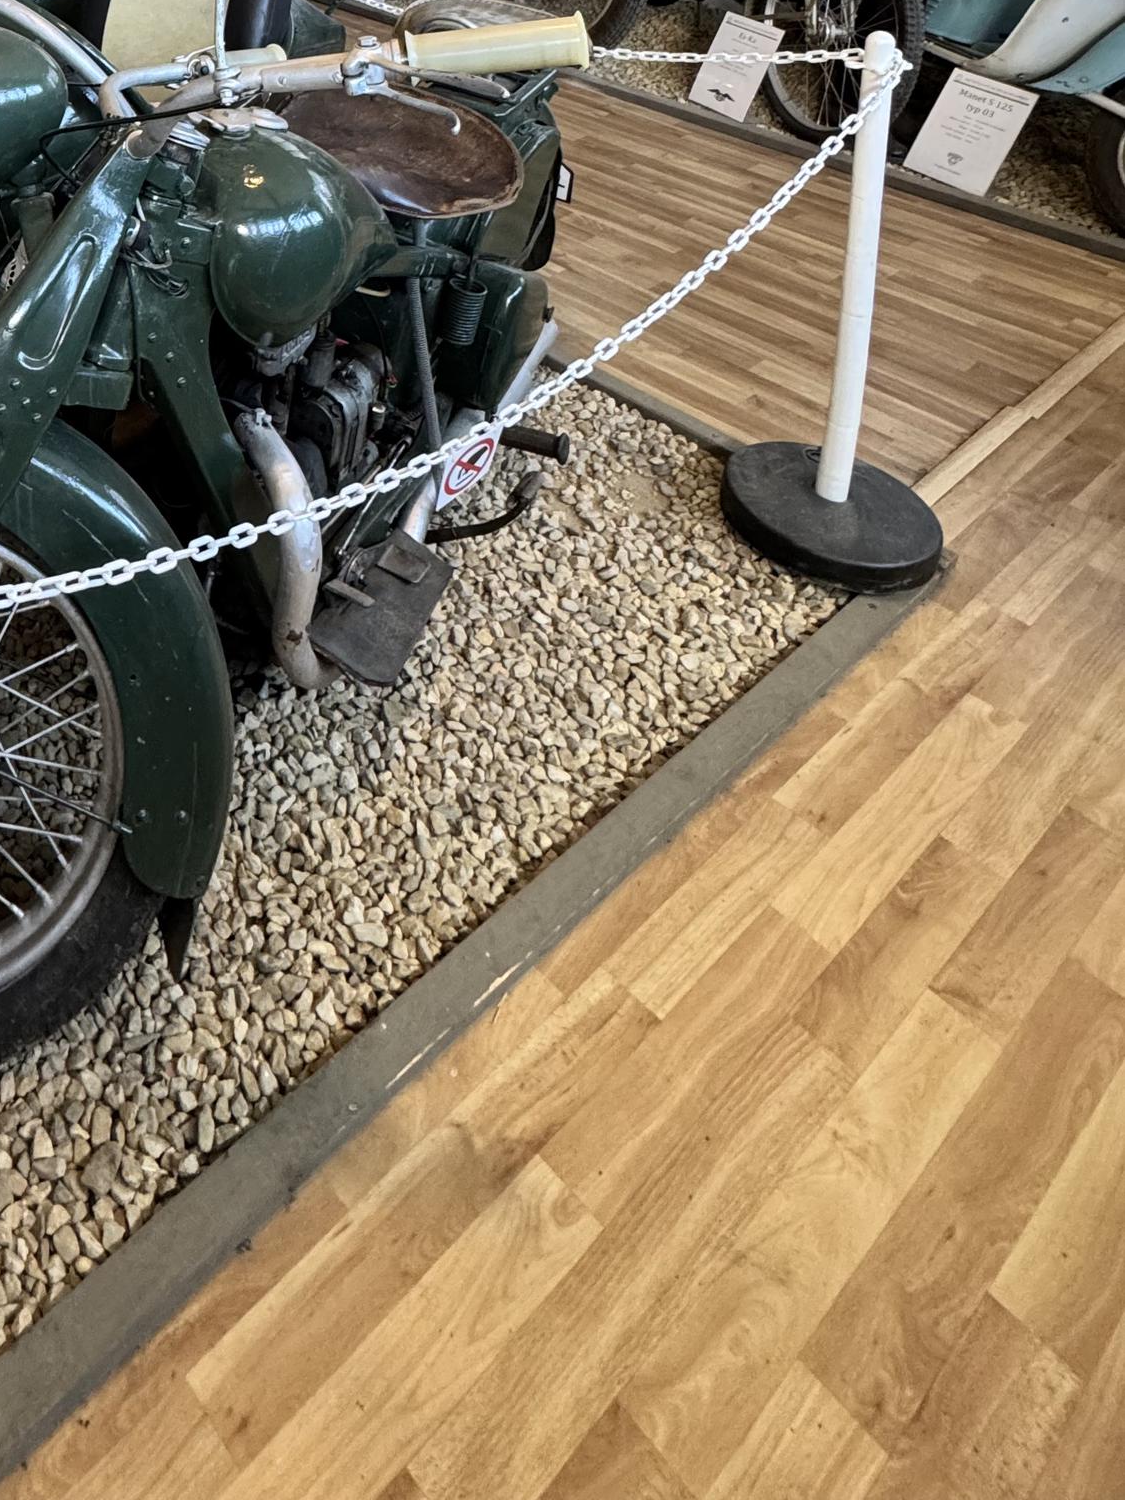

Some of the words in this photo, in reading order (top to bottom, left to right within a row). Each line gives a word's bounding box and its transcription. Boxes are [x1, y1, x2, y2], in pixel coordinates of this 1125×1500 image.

[959, 88, 987, 103] Manet
[996, 101, 1014, 112] 125
[966, 103, 981, 114] typ
[982, 108, 995, 118] 03
